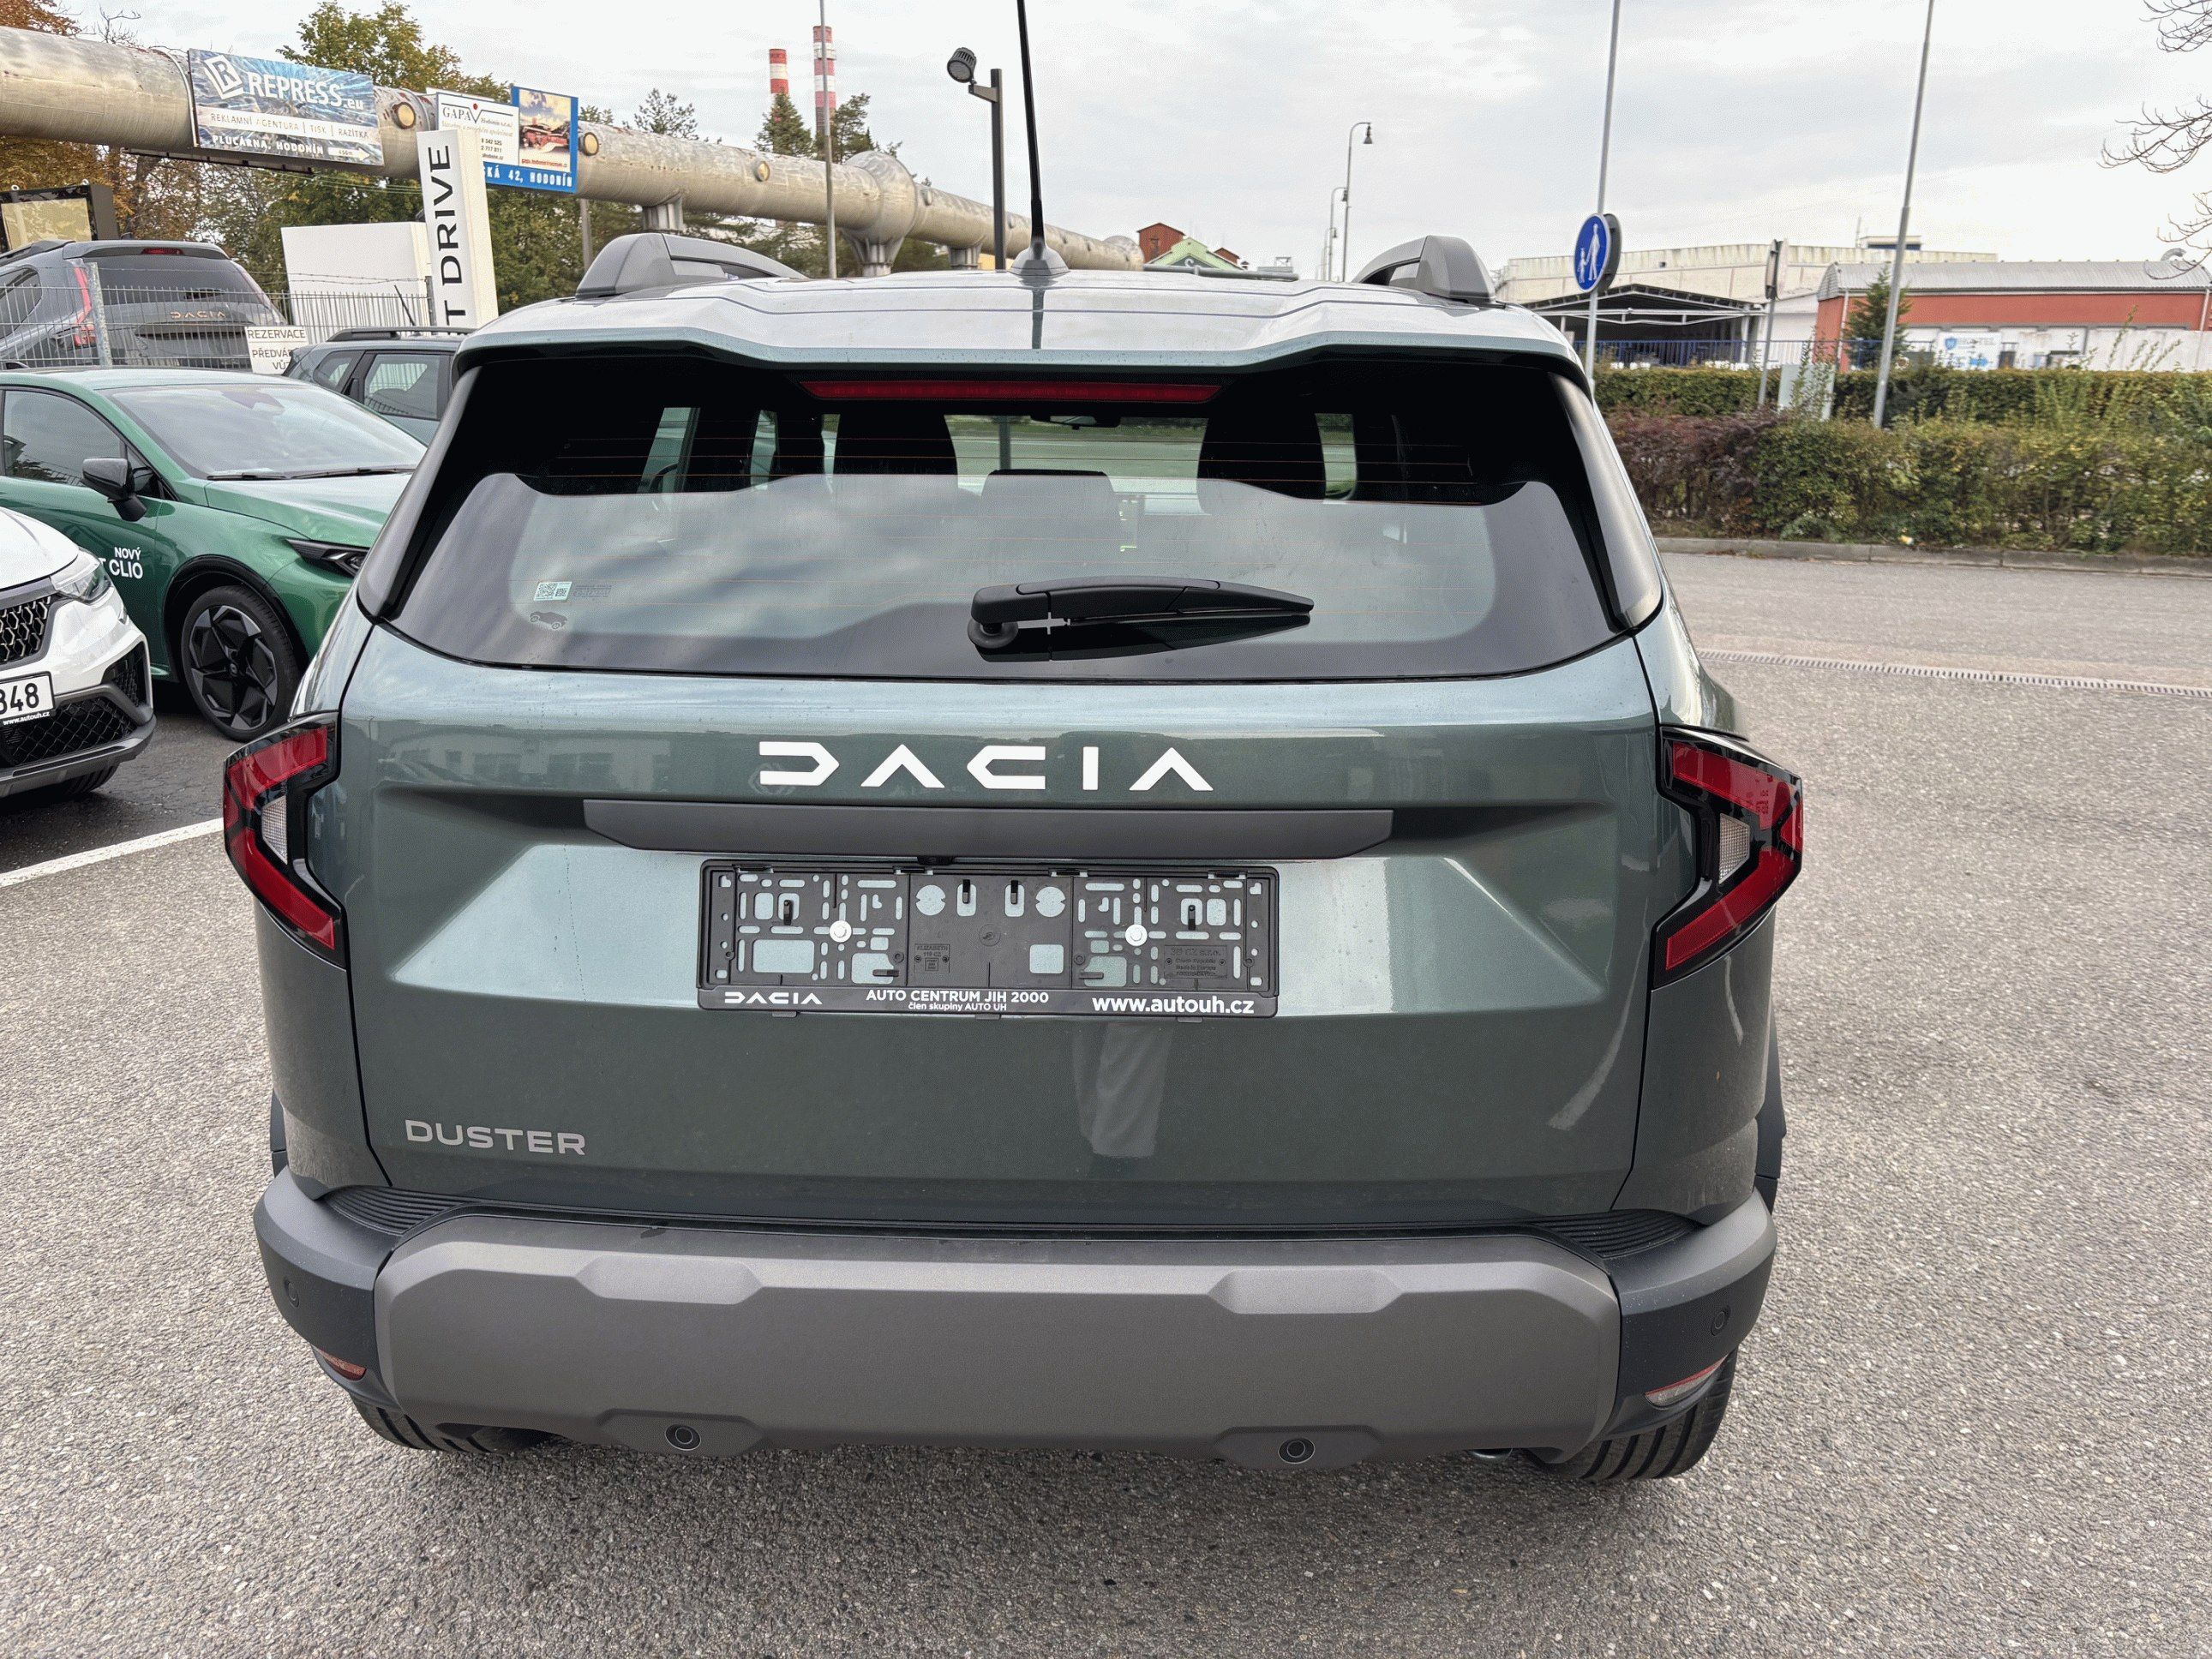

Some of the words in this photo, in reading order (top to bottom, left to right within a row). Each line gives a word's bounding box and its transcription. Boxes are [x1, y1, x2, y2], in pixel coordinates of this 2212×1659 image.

[276, 141, 324, 155] HODONÍN
[508, 170, 524, 183] 42,
[428, 145, 464, 286] DRIVE
[248, 329, 306, 339] REZERVACE
[114, 547, 141, 560] NOVÝ
[109, 559, 144, 579] CLIO
[759, 741, 1214, 791] DACIA
[724, 991, 823, 1004] DACIA
[866, 990, 906, 1002] AUTO
[910, 991, 980, 1003] CENTRUM
[985, 991, 1007, 1003] JIH
[1010, 991, 1049, 1003] 2000
[908, 1001, 926, 1010] člen
[929, 1002, 962, 1012] skupiny
[964, 1003, 992, 1011] AUTO
[993, 1003, 1007, 1011] UH
[1092, 996, 1255, 1014] www.autouh.cz
[405, 1119, 585, 1155] DUSTER
